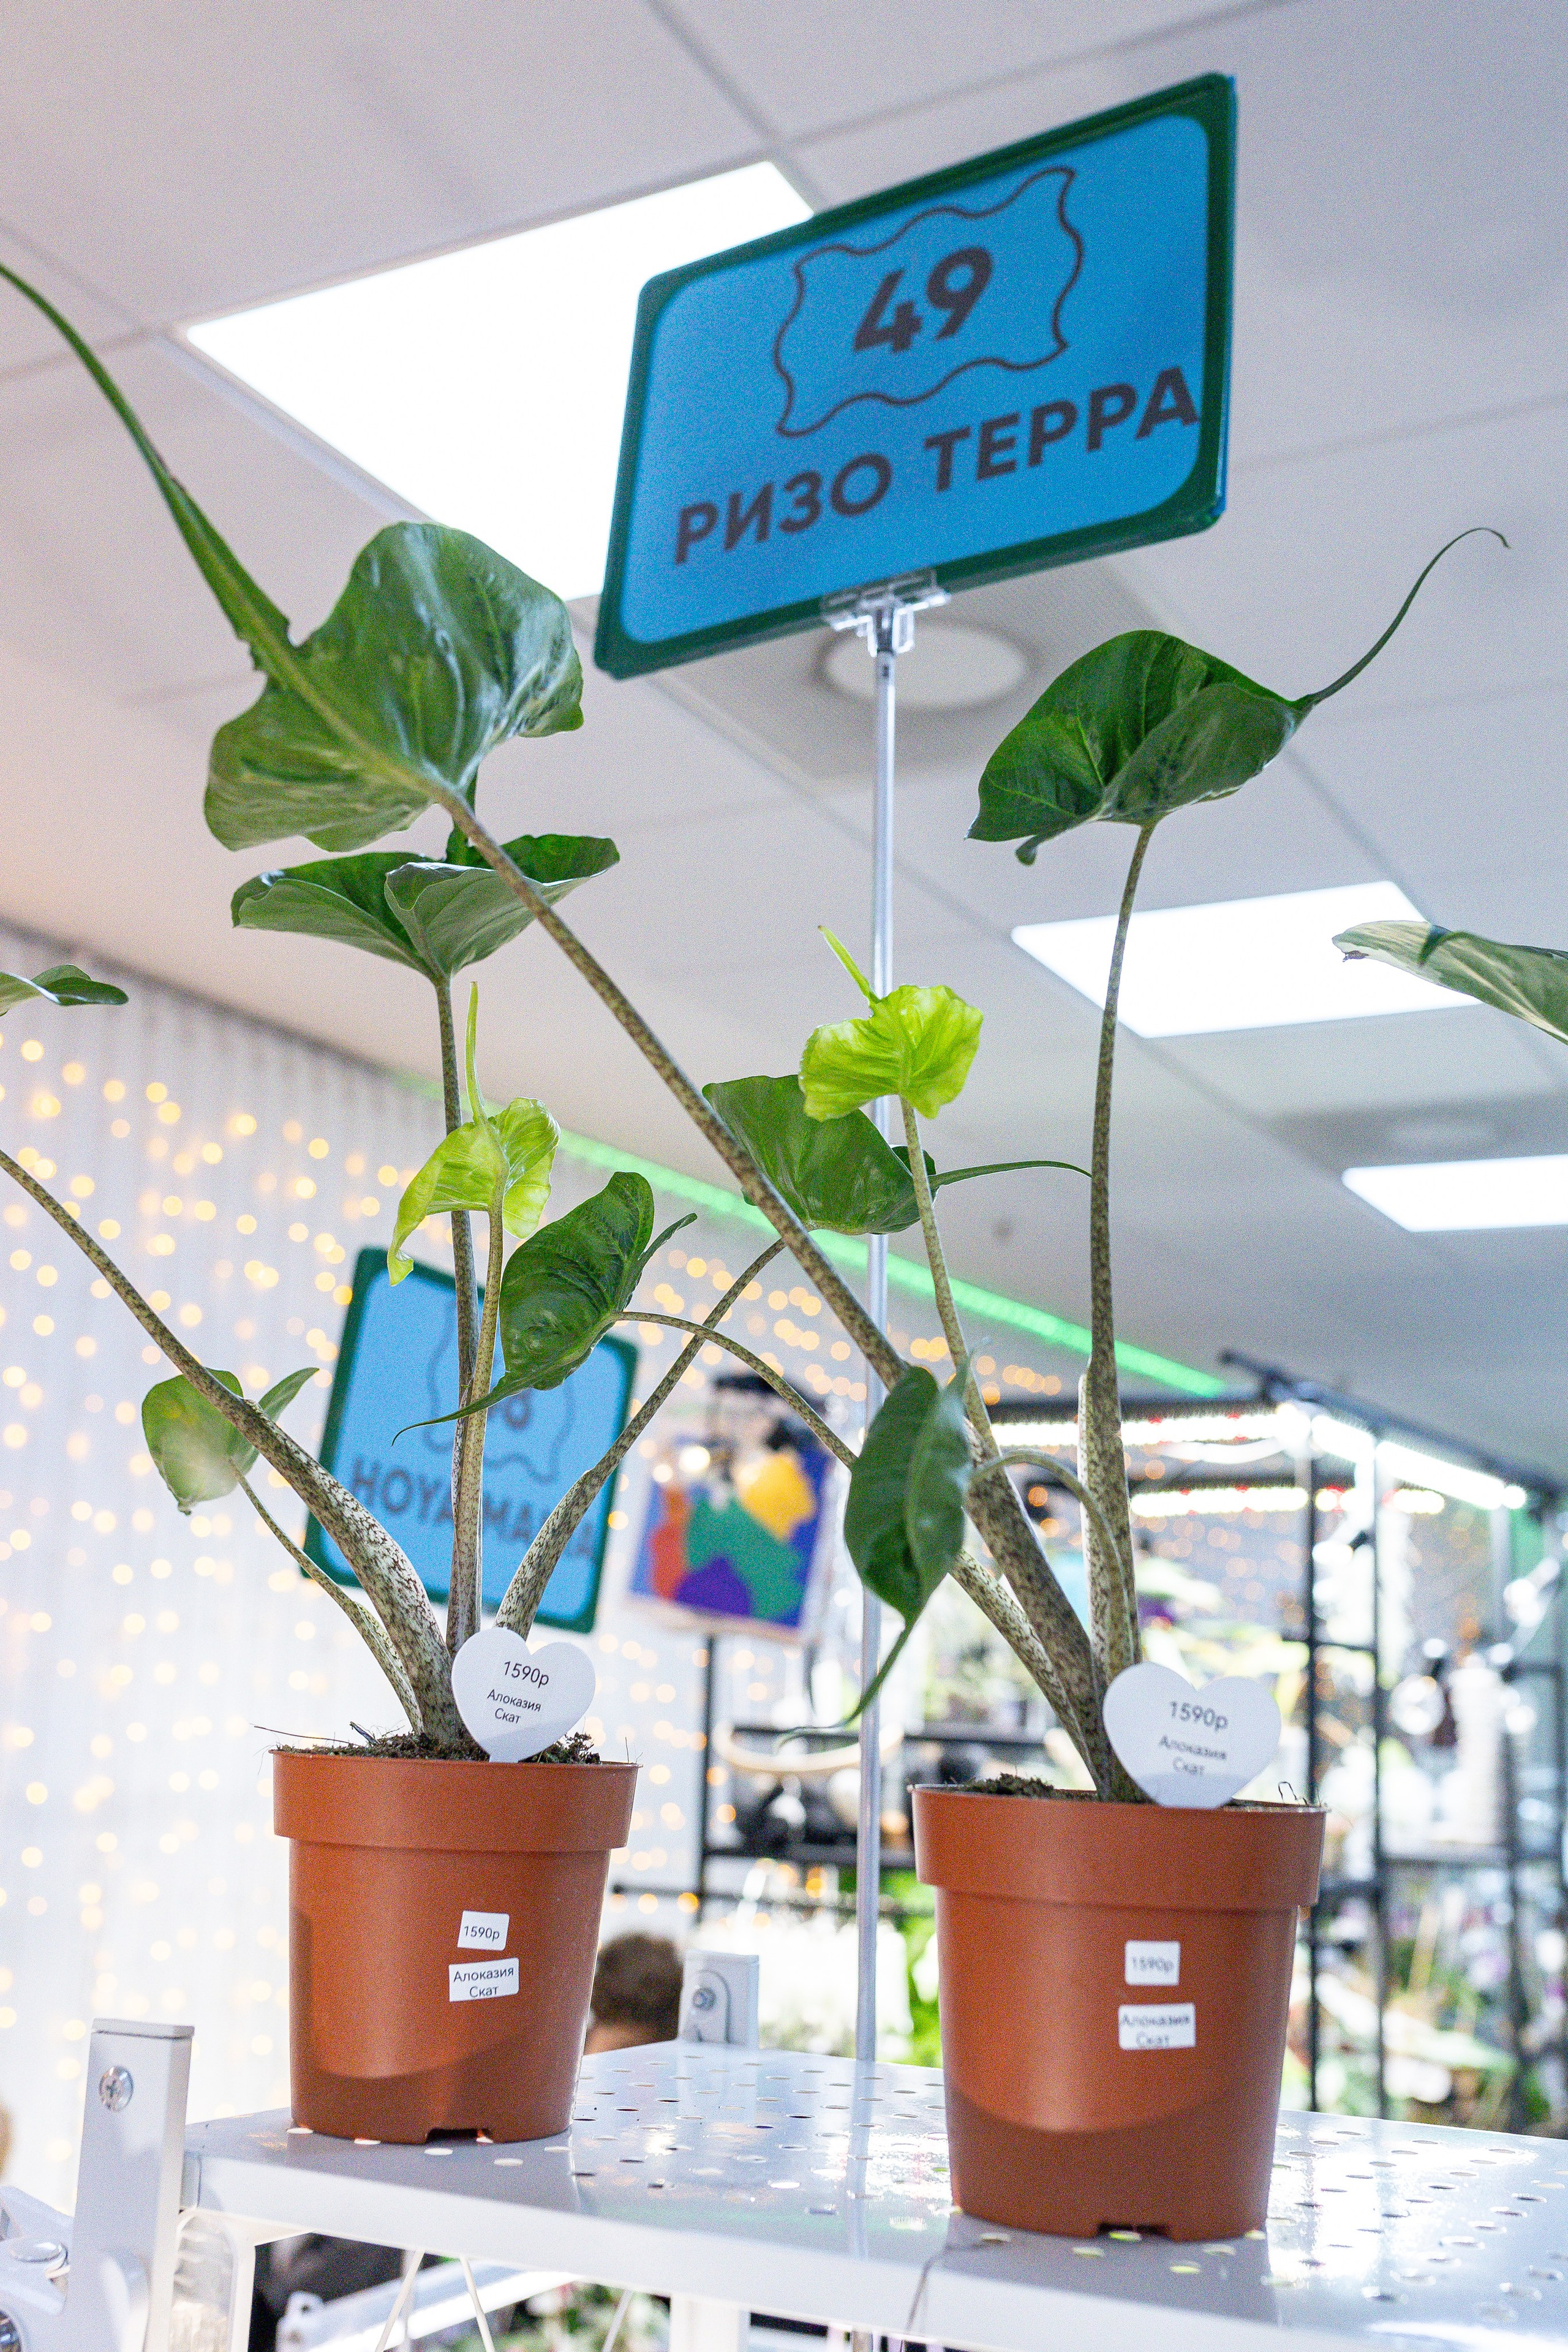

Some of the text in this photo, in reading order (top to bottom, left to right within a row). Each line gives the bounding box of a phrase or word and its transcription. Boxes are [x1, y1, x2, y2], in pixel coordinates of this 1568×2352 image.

[852, 246, 993, 355] 49
[674, 366, 1199, 565] РИЗО ТЕРРА
[504, 1661, 549, 1688] 1590р
[487, 1689, 541, 1712] Алоказия
[495, 1708, 521, 1724] Скат
[1169, 1700, 1229, 1732] 1590р
[464, 1926, 500, 1942] 1590р
[453, 1967, 514, 1982] Алоказия
[469, 1986, 499, 1998] Скат
